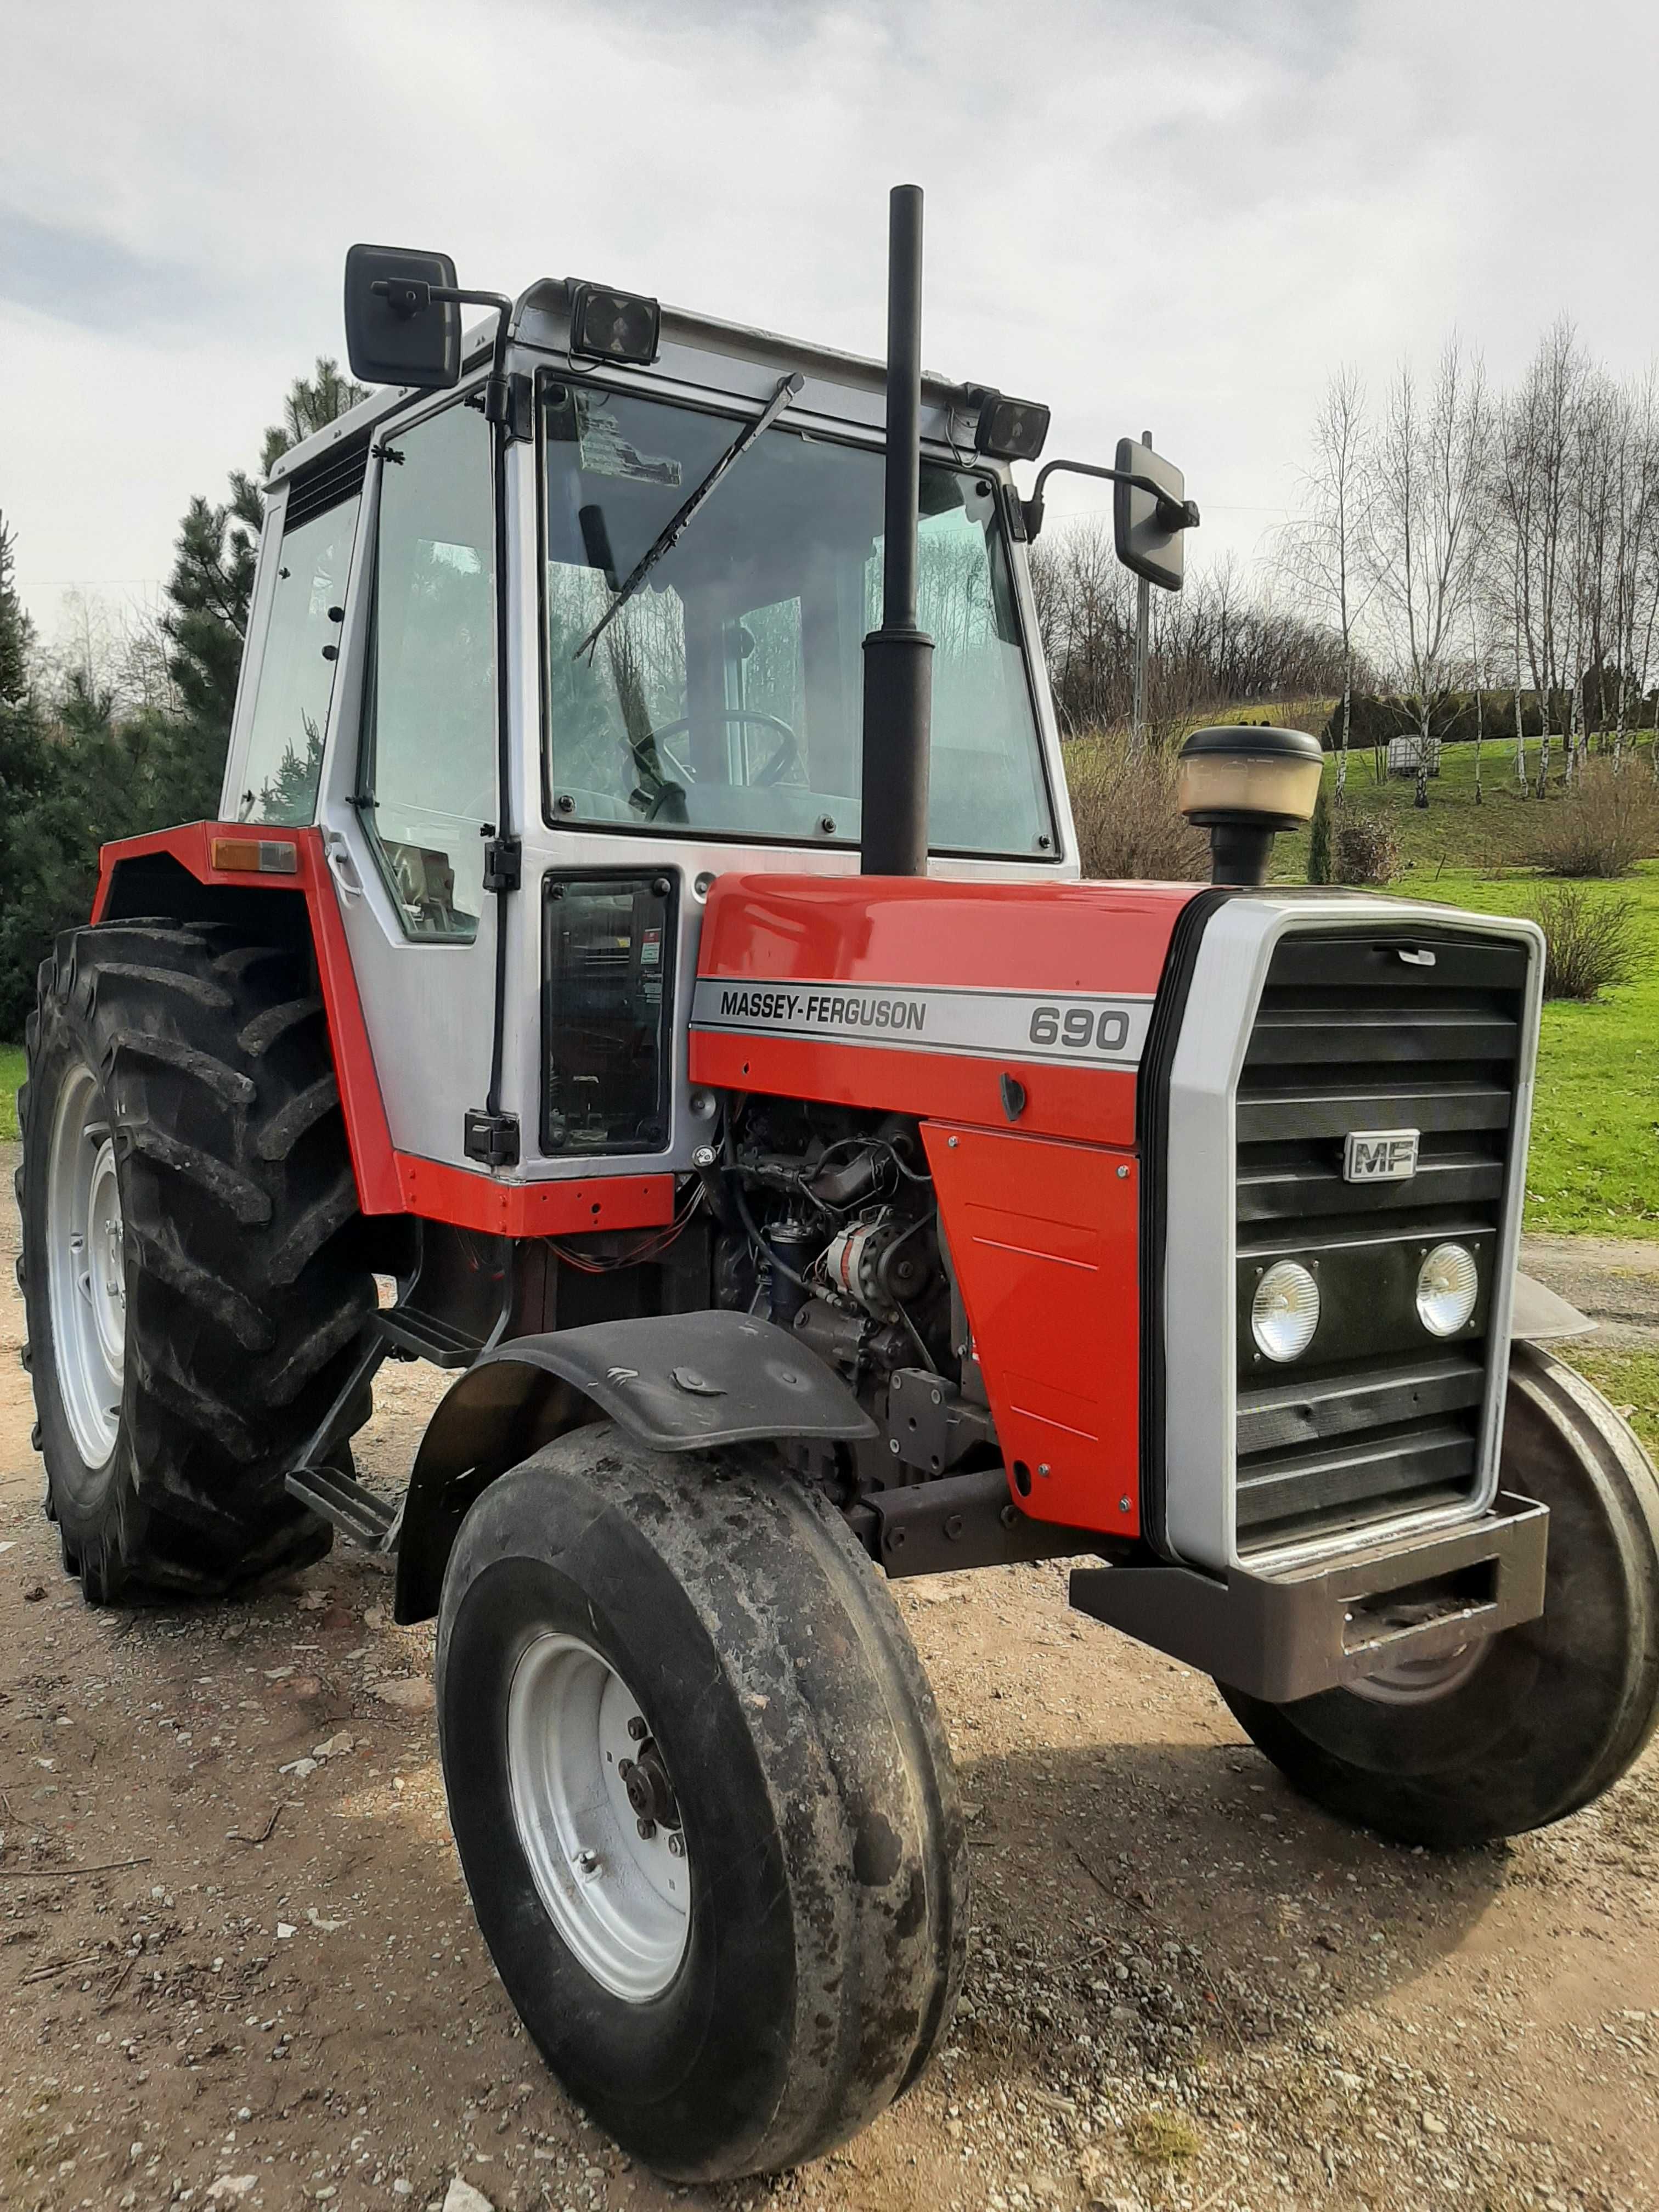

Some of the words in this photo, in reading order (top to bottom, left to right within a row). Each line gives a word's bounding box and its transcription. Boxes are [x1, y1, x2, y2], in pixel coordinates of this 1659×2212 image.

[720, 991, 927, 1031] MASSEY-FERGUSON
[1029, 1007, 1130, 1051] 690
[1354, 1141, 1414, 1173] MF
